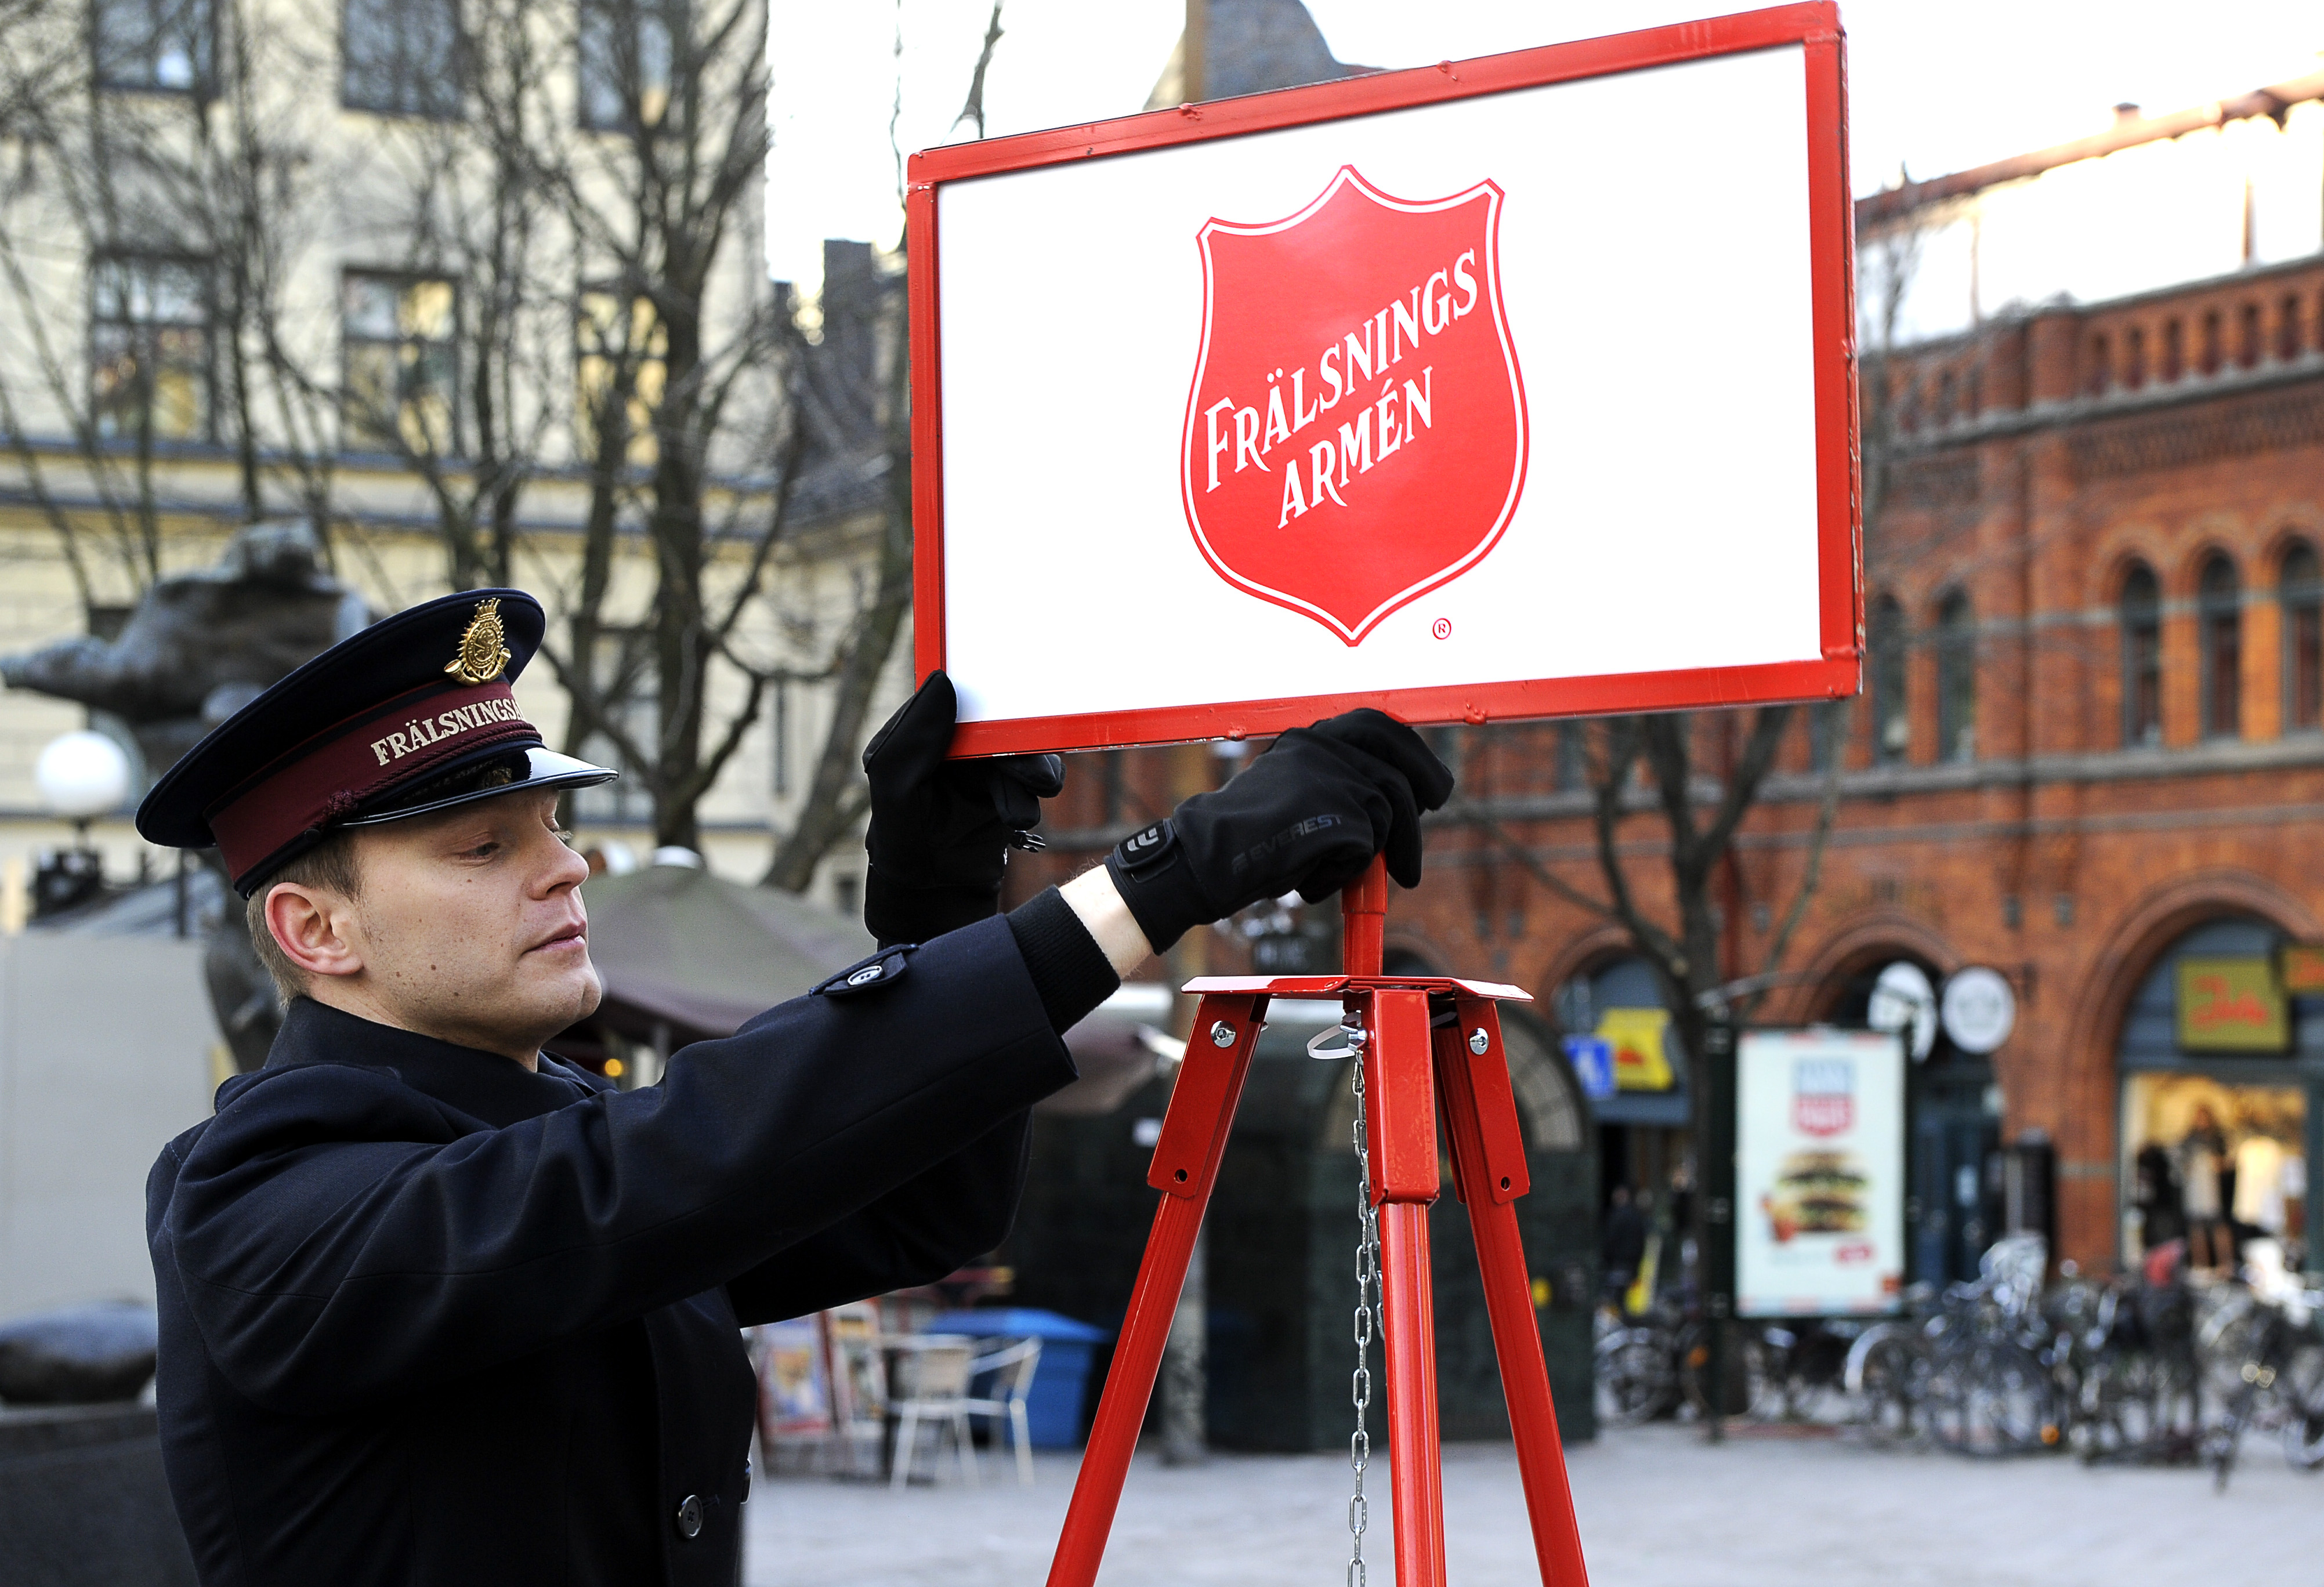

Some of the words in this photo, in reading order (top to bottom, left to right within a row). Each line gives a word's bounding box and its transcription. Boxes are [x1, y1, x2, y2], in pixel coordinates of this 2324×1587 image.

[1204, 247, 1478, 494] FRÄLSNINGS
[1277, 365, 1433, 530] ARMÉN
[1248, 813, 1343, 860] EVEREST
